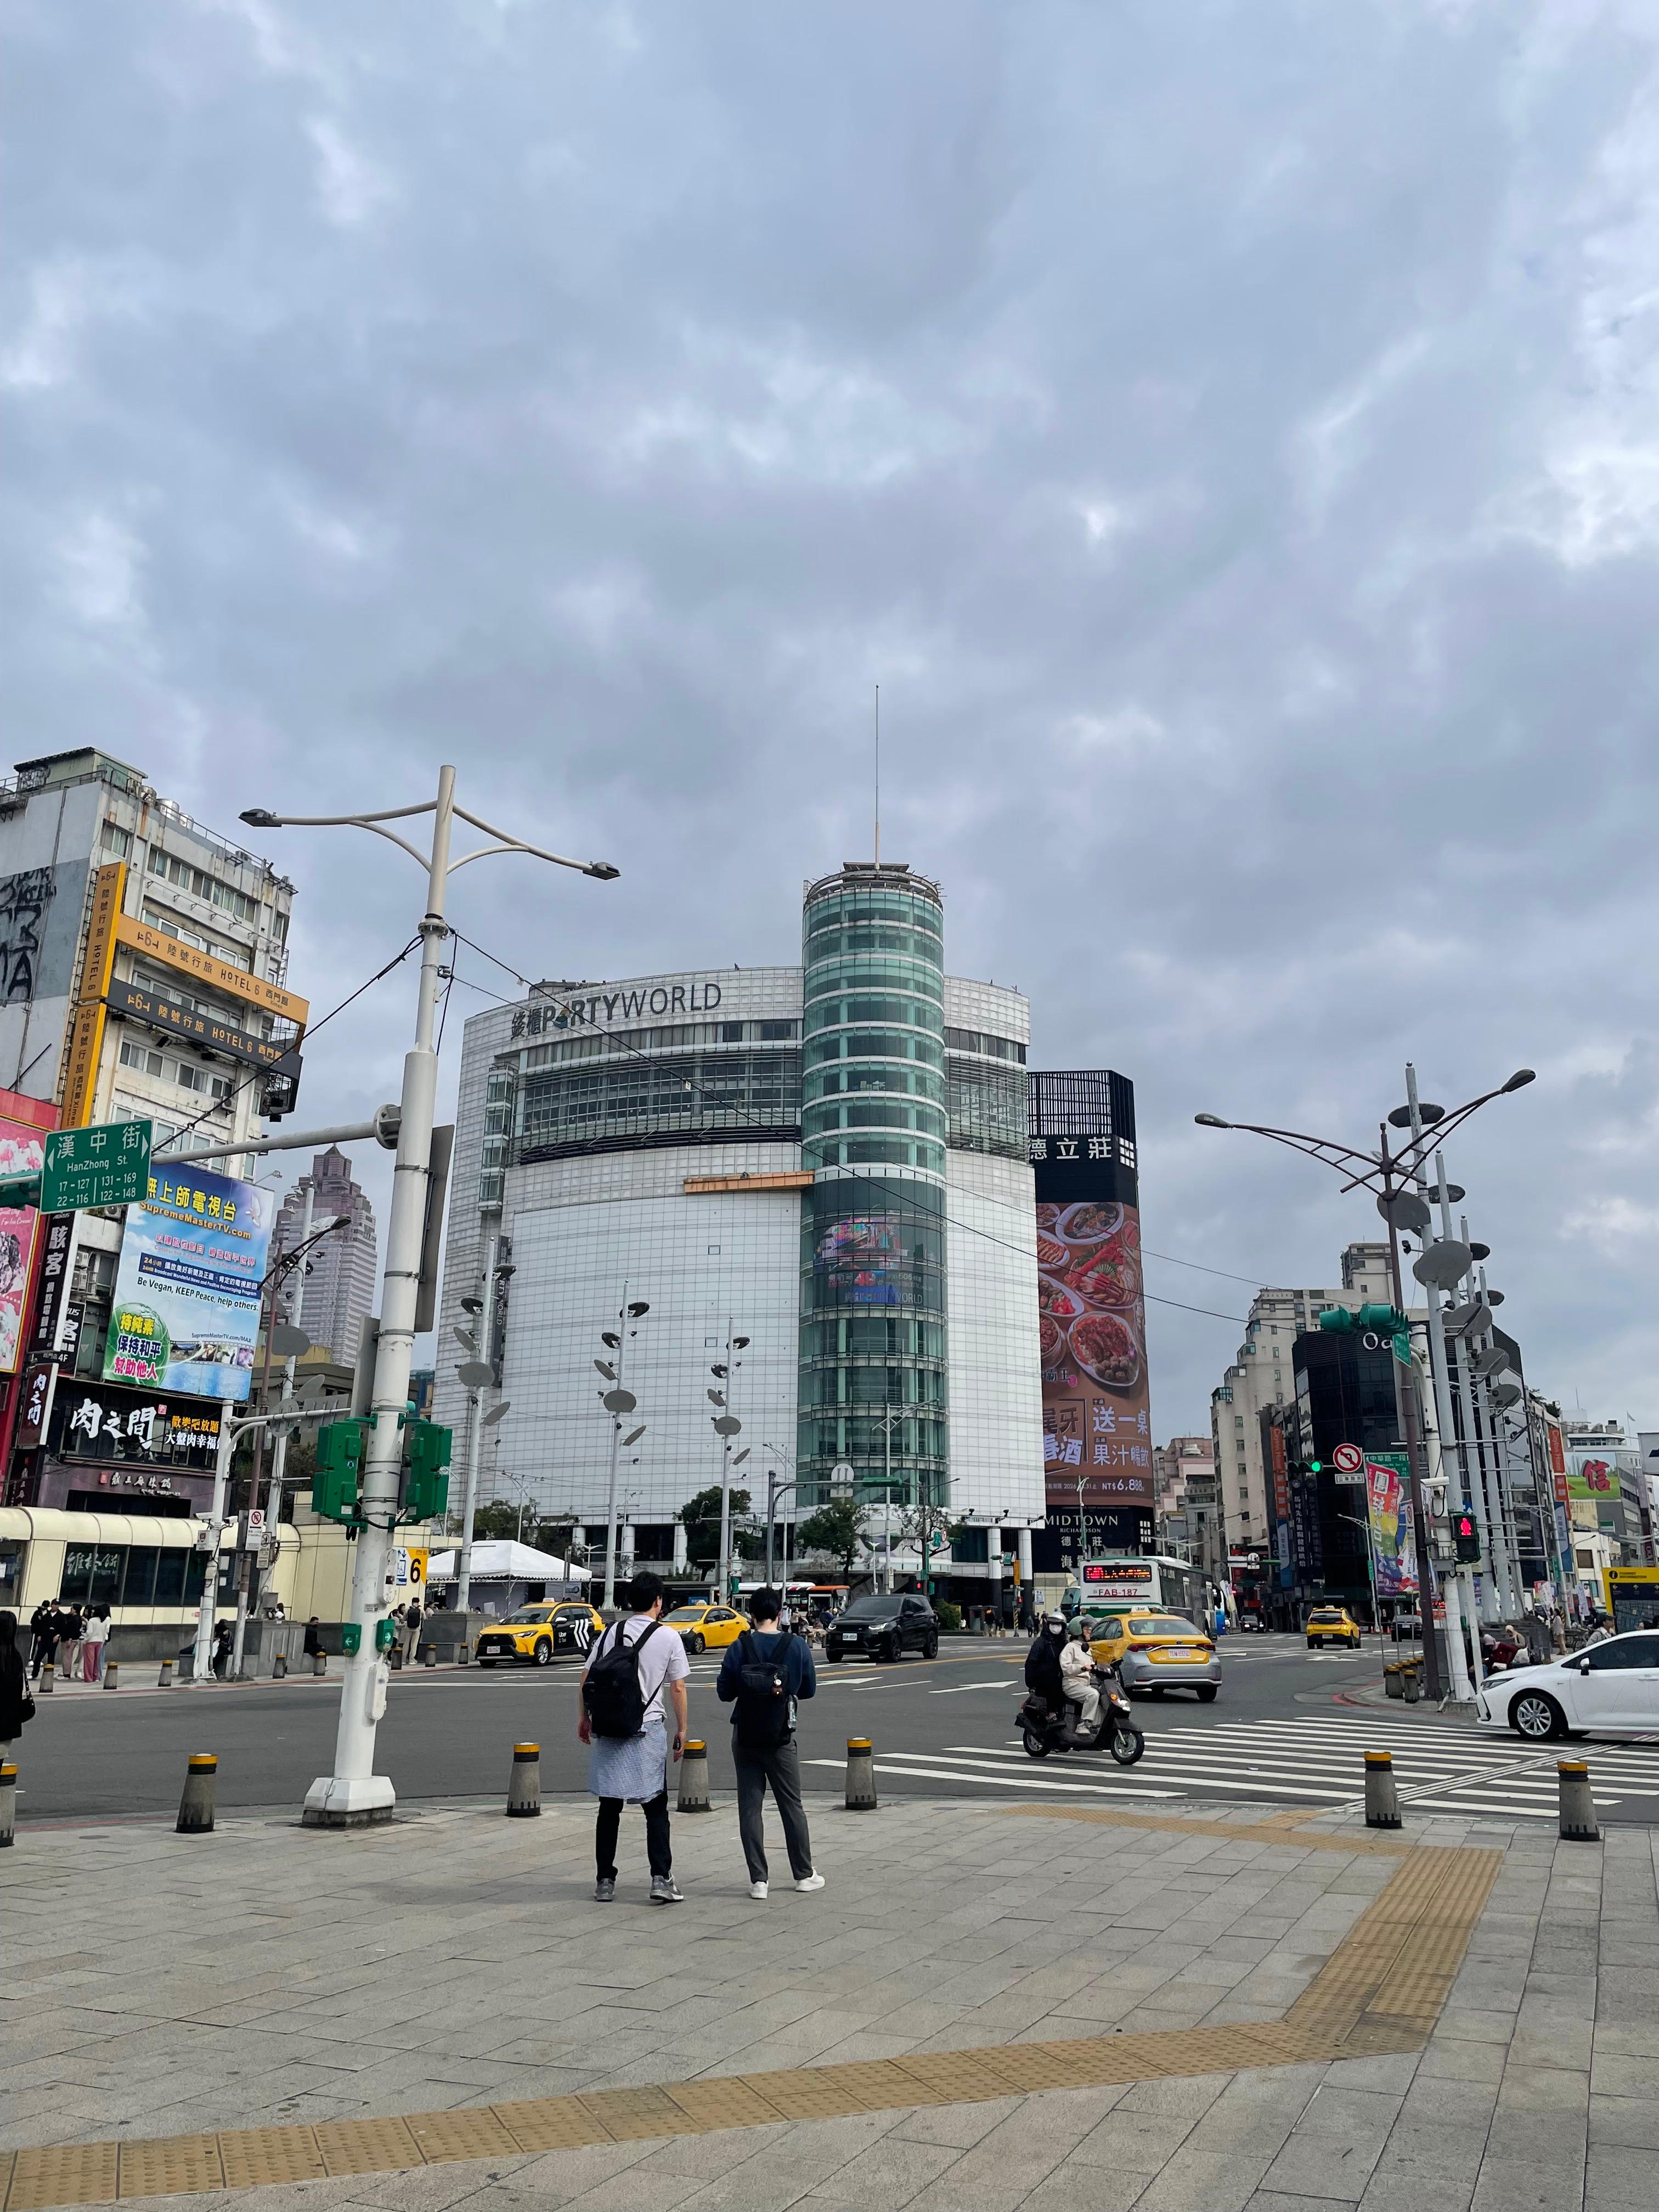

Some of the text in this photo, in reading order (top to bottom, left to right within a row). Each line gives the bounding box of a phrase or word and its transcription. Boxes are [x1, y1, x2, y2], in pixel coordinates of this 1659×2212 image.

[89, 945, 102, 981] HOTEL
[167, 943, 213, 975] 陸號行旅
[221, 968, 260, 996] HOTEL 6
[266, 988, 289, 1006] 西門館
[158, 1004, 205, 1033] 陸號行旅
[511, 1006, 542, 1041] 錢櫃
[212, 1026, 253, 1053] HOTEL 6
[70, 1101, 80, 1126] Ximen
[57, 1125, 140, 1159] 漢中街
[1029, 1136, 1112, 1160] 德立莊
[67, 1159, 109, 1172] HanZhong
[148, 1177, 236, 1222] 無上師電視台
[140, 1201, 251, 1240] SupremeMasterTV.com
[45, 1225, 69, 1276] 駭客
[137, 1277, 146, 1286] Be
[149, 1280, 173, 1294] Vegan,
[176, 1285, 195, 1297] KEEP
[195, 1291, 216, 1303] Peace,
[218, 1296, 233, 1308] help
[117, 1335, 161, 1359] 保持和平
[114, 1357, 158, 1380] 幫助他人
[27, 1373, 47, 1426] 肉之間
[70, 1398, 157, 1449] 肉之間
[1092, 1406, 1148, 1435] 送一桌
[1093, 1444, 1150, 1468] 果汁暢飲
[1582, 1459, 1610, 1492] 信
[1045, 1515, 1118, 1526] MIDTOWN
[410, 1558, 421, 1583] 6
[1098, 1588, 1138, 1596] FAB-187
